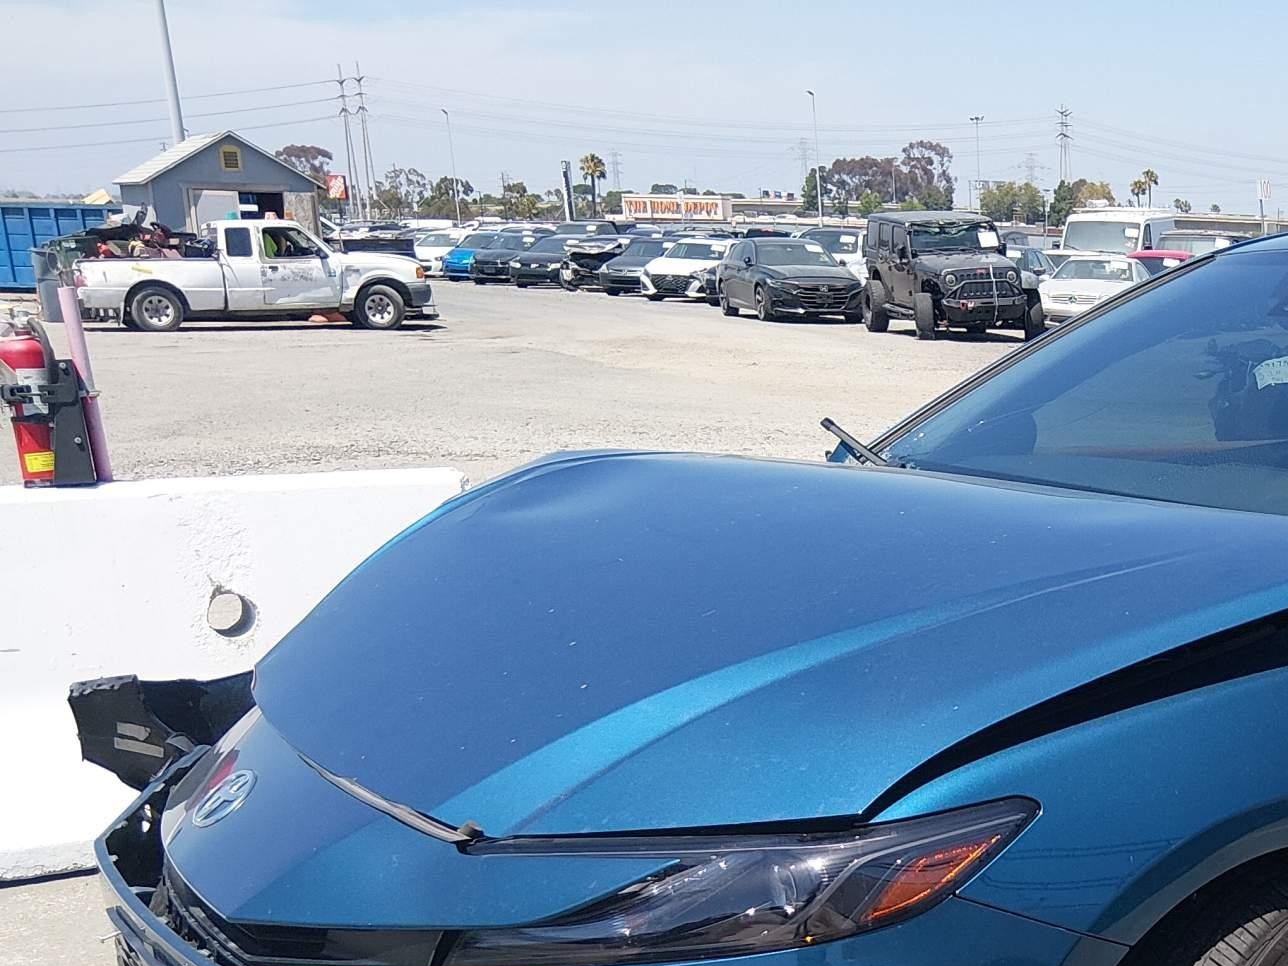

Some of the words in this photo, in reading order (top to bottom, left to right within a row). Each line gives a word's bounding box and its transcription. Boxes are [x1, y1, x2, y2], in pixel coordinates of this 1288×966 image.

[625, 200, 648, 214] THE
[651, 200, 681, 215] HOME
[684, 201, 718, 217] DEPOT
